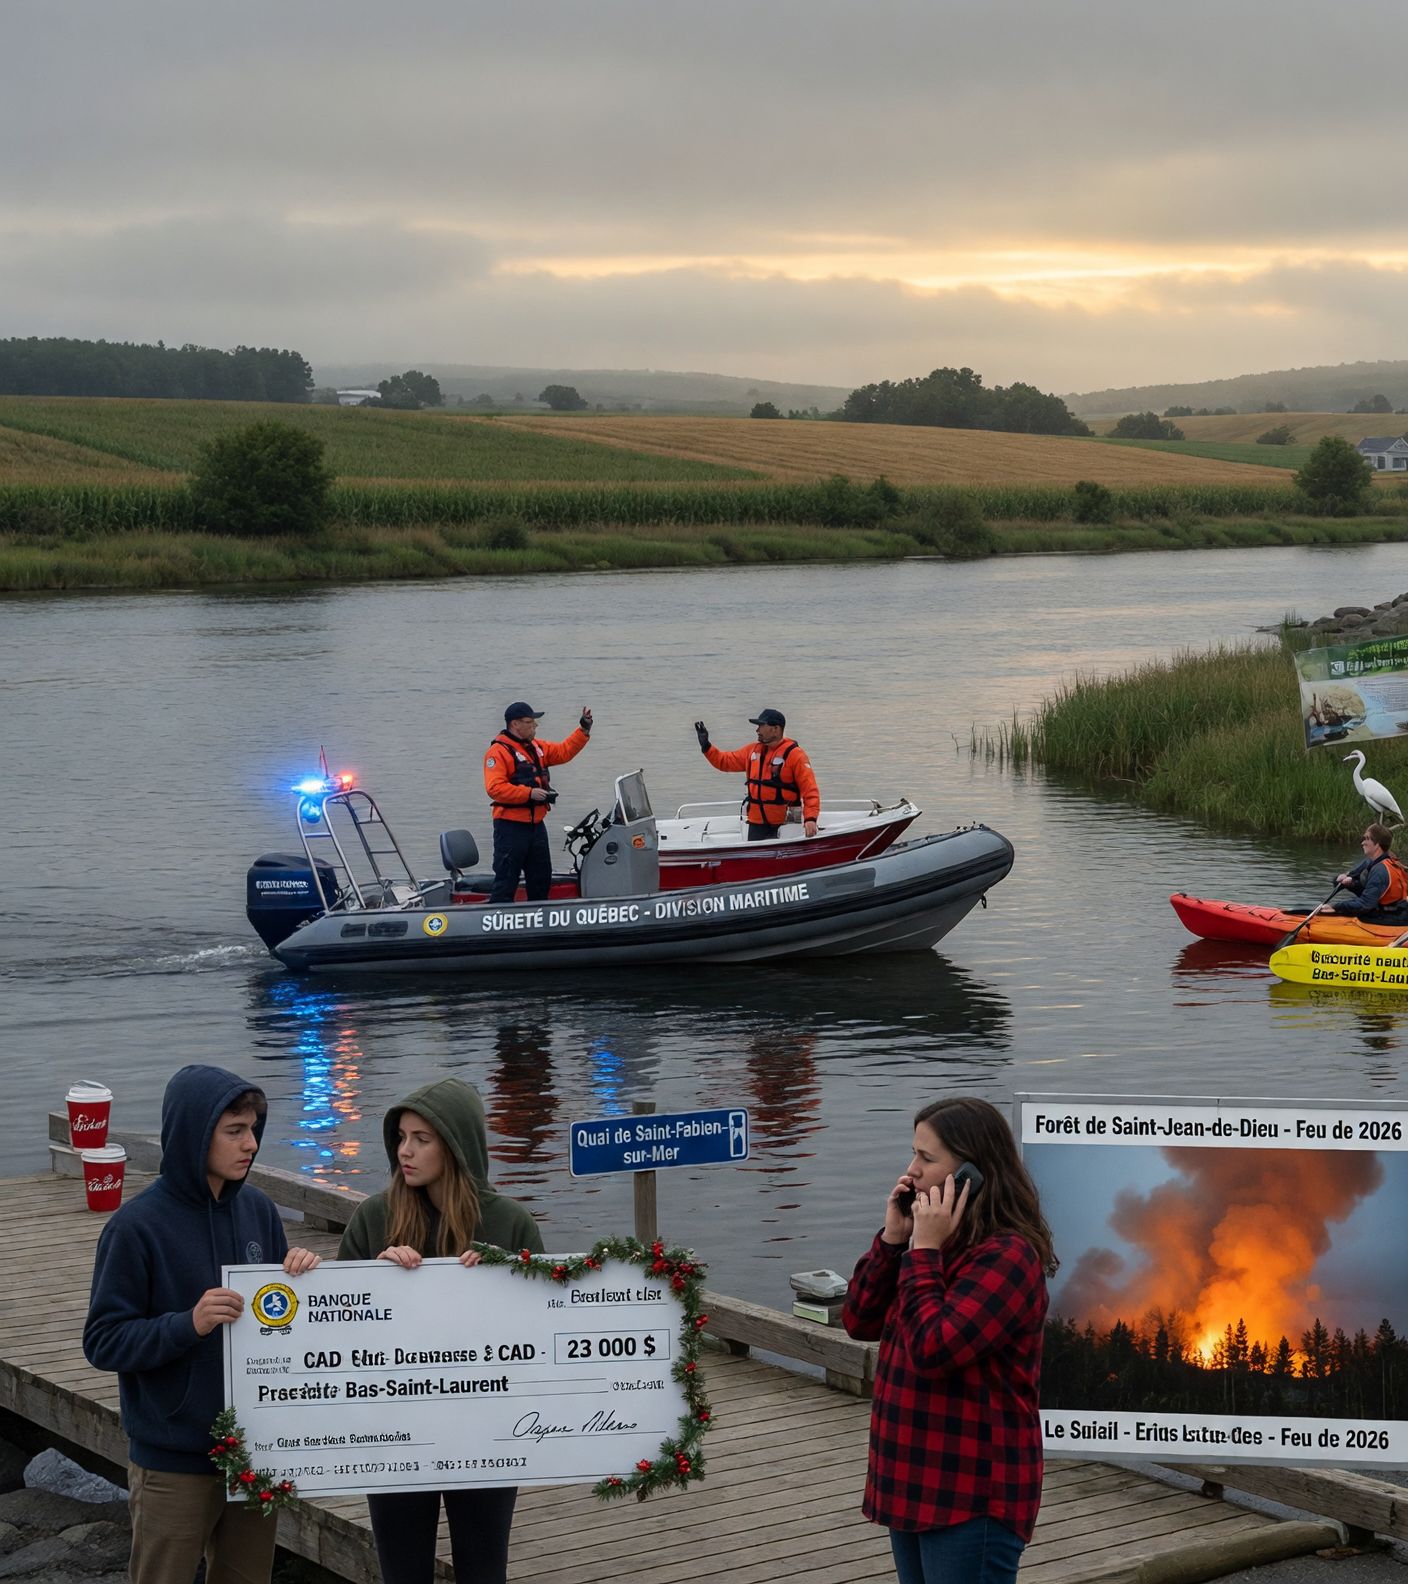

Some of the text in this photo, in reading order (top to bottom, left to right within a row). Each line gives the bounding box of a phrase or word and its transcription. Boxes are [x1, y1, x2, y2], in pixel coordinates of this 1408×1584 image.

[482, 908, 544, 931] SÛRETÉ
[549, 910, 570, 927] DU
[576, 904, 639, 925] QUÉBEC
[655, 896, 725, 919] DIVISION
[729, 883, 809, 911] MARITIME
[577, 1128, 610, 1148] Quai
[614, 1128, 632, 1144] de
[1035, 1115, 1081, 1134] Forêt
[1086, 1116, 1107, 1135] de
[1112, 1116, 1279, 1138] Saint-Jean-de-Dieu
[1296, 1120, 1327, 1139] Feu
[1333, 1120, 1353, 1139] de
[1358, 1121, 1402, 1141] 2026
[623, 1144, 680, 1164] sur-Mer
[308, 1292, 372, 1308] BANQUE
[308, 1308, 393, 1323] NATIONALE
[304, 1351, 342, 1368] CAD
[499, 1344, 536, 1361] CAD
[567, 1334, 656, 1359] 23 000 $
[346, 1376, 509, 1398] Bas-Saint-Laurent
[1045, 1420, 1065, 1438] Le
[1281, 1428, 1312, 1446] Feu
[1318, 1428, 1340, 1447] de
[1346, 1430, 1389, 1450] 2026
